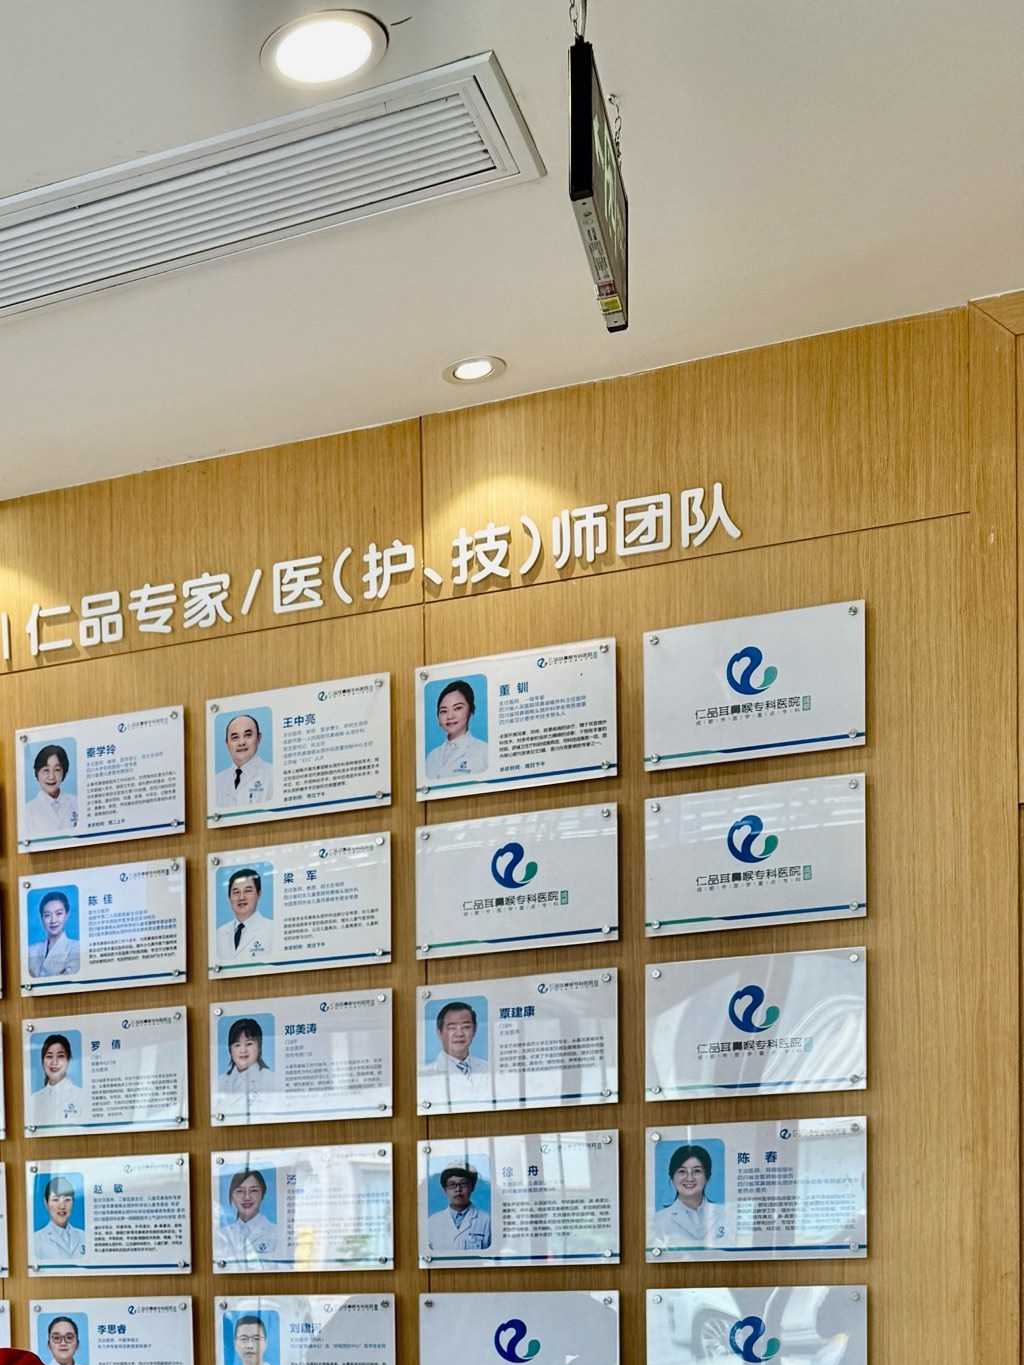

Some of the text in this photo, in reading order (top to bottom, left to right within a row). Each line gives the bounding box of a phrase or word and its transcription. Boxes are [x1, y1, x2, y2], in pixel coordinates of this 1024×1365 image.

[695, 696, 800, 720] 仁品耳鼻喉专科医院
[283, 713, 316, 729] 王中亮
[283, 869, 317, 884] 梁军
[696, 866, 801, 887] 仁品耳鼻喉专科医院
[462, 890, 559, 911] 仁品耳鼻喉专科医院
[499, 1005, 535, 1019] 覃建康
[284, 1023, 317, 1036] 邓美涛
[697, 1037, 803, 1055] 仁品耳鼻喉专科医院
[737, 1151, 777, 1164] 陈春
[502, 1165, 538, 1178] 徐舟
[93, 1183, 124, 1194] 赵敏
[97, 1324, 127, 1335] 李思睿
